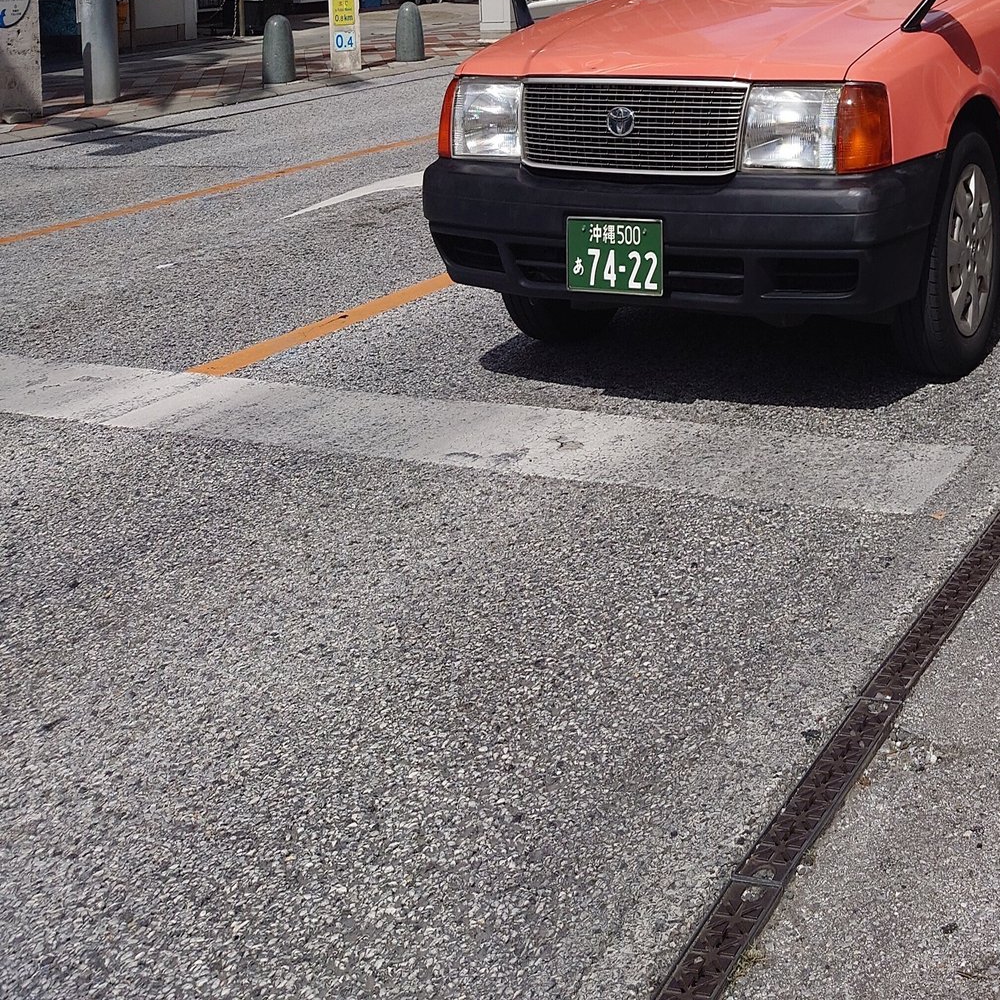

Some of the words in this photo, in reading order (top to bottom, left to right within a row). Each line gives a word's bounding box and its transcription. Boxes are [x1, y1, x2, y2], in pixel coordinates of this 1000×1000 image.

[335, 34, 354, 49] 0.4
[572, 256, 584, 276] あ
[587, 248, 659, 290] 74-22
